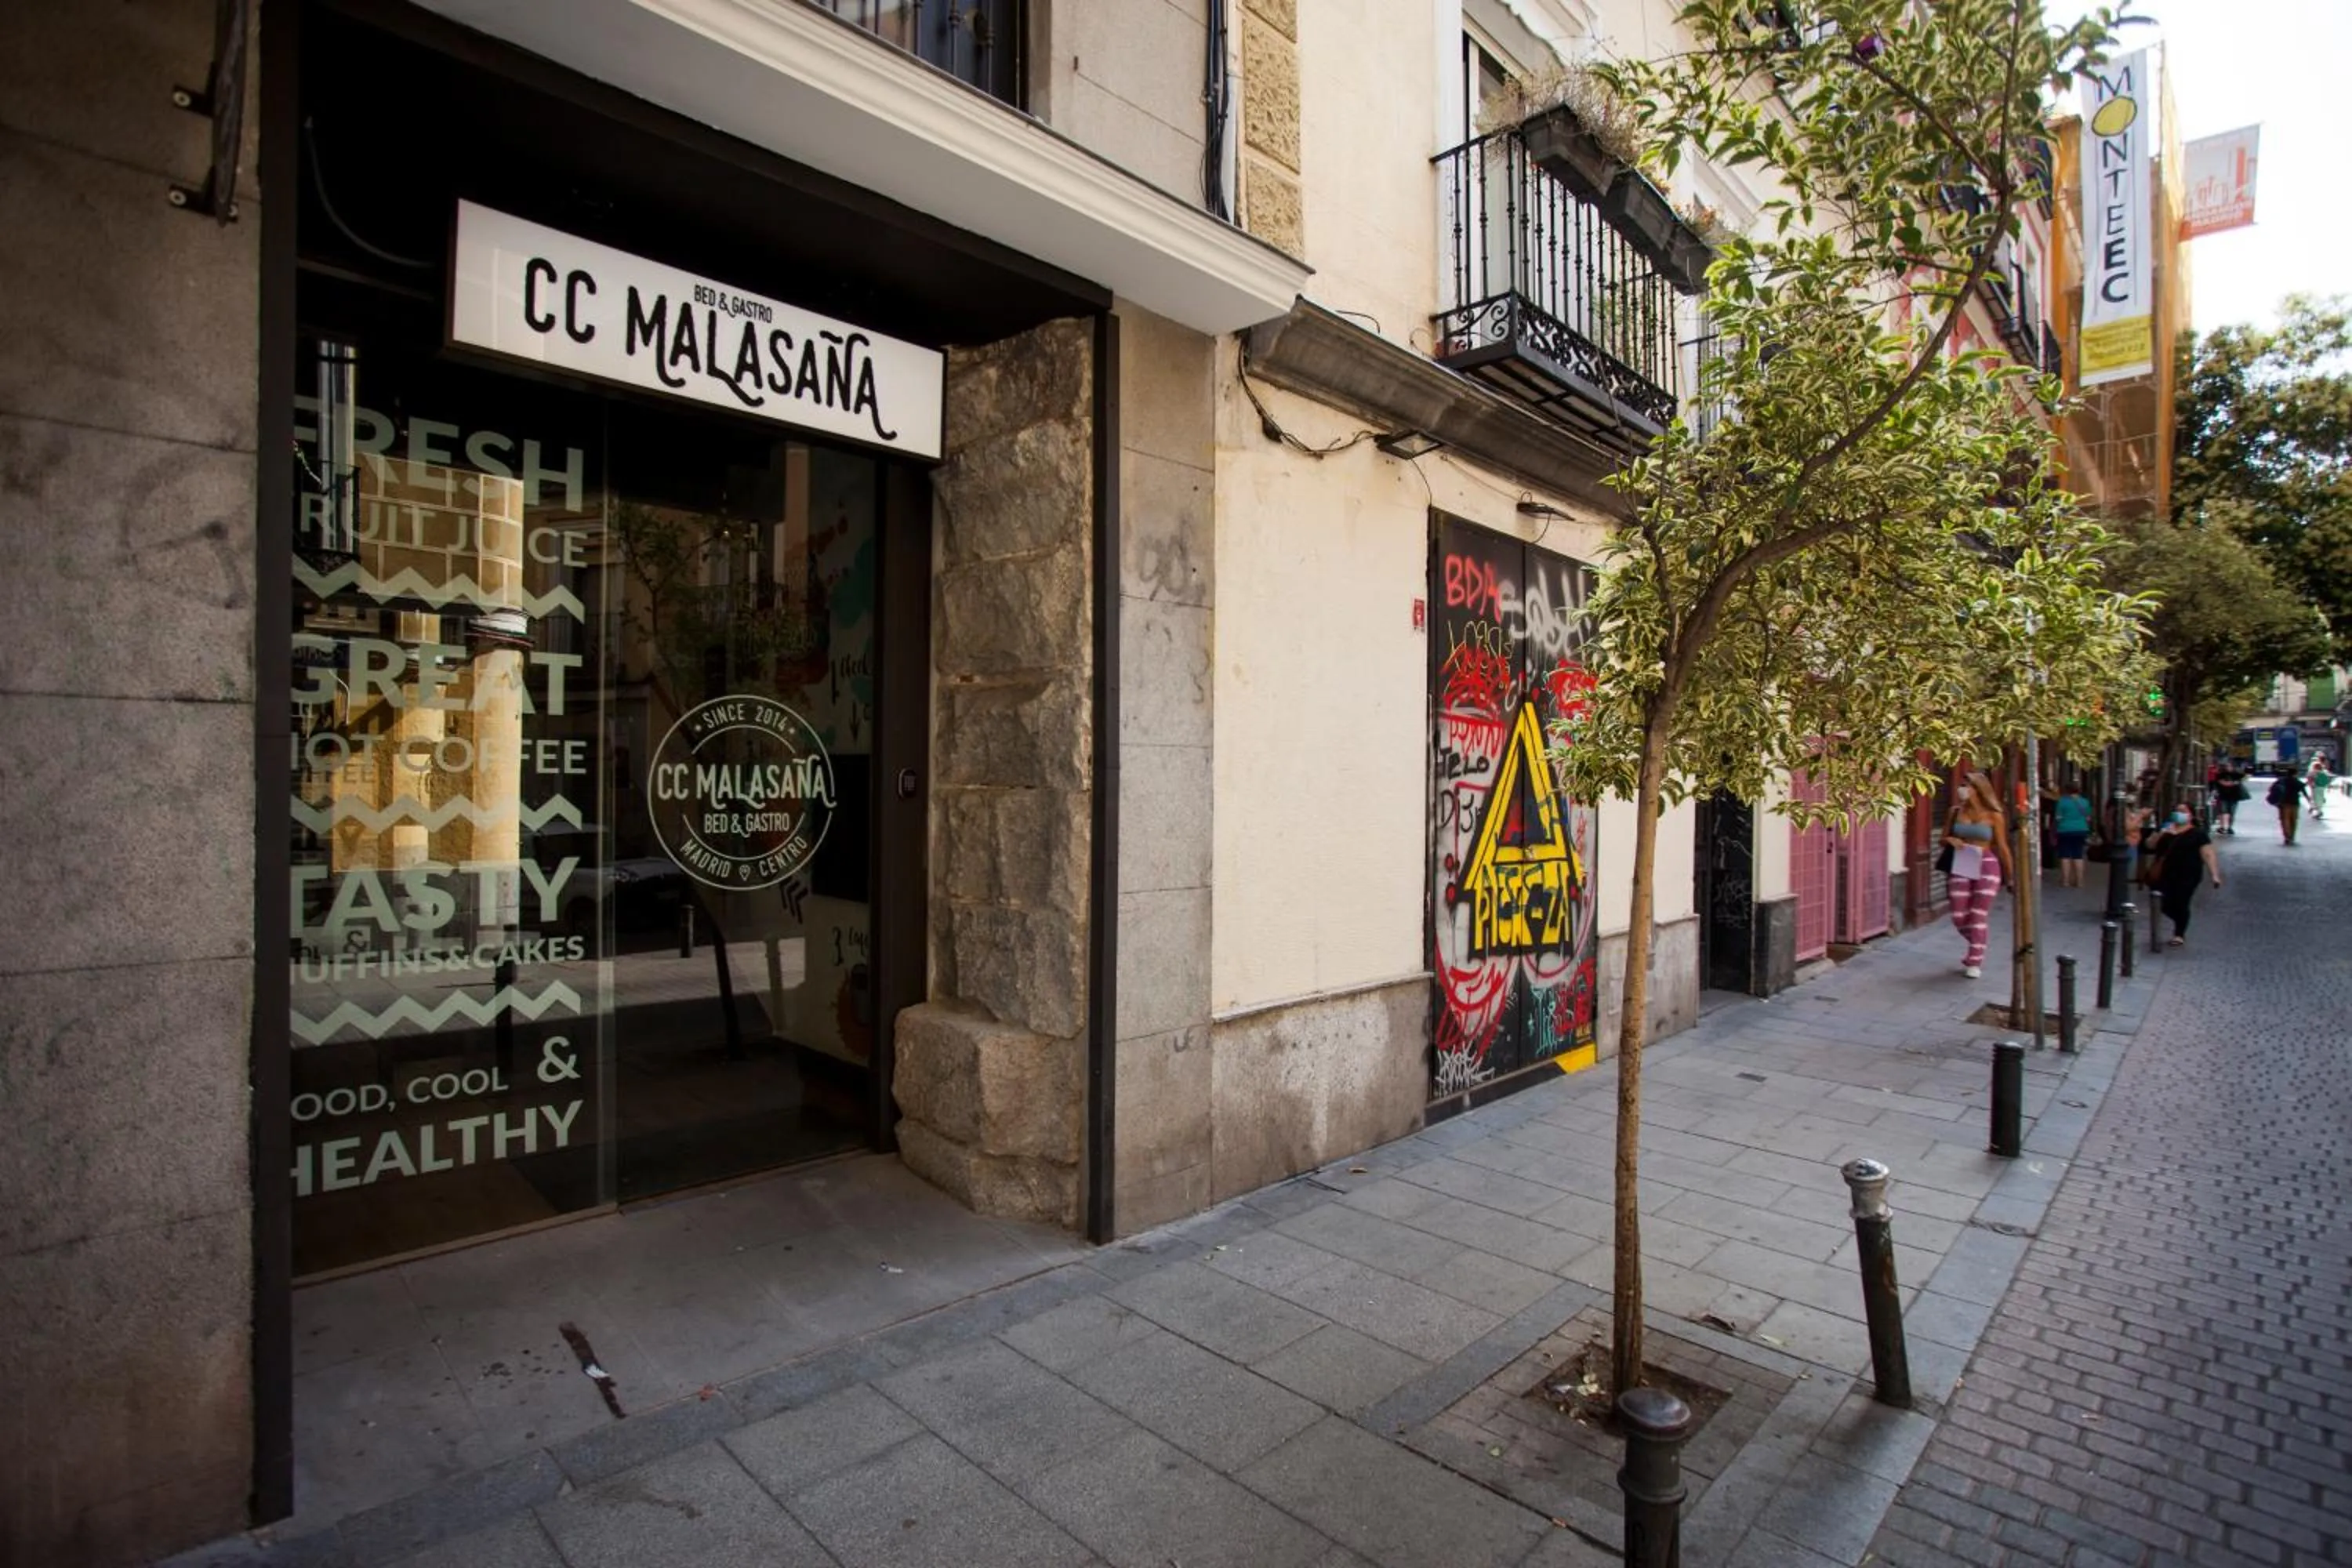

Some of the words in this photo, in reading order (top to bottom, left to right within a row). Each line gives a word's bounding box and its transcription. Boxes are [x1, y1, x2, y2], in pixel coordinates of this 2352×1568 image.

[694, 284, 716, 306] BED
[718, 292, 735, 318] &
[731, 297, 773, 324] GASTRO
[524, 258, 597, 343] CC
[626, 286, 897, 441] MALASAÑA
[448, 516, 589, 568] JUCE
[291, 633, 583, 716] GREAT
[701, 703, 746, 730] SINCE
[755, 706, 788, 731] 2014
[291, 731, 386, 773] OT
[658, 762, 689, 800] CC
[696, 754, 837, 810] MALASAÑA
[703, 814, 728, 833] BED
[731, 815, 750, 838] &
[746, 813, 790, 833] GASTRO
[680, 838, 731, 879] MADRID
[758, 836, 809, 878] CENTRO
[290, 856, 581, 938] TASTY
[291, 935, 585, 985] UFFINS&CAKES
[406, 1066, 509, 1103] COOL
[536, 1036, 582, 1083] &
